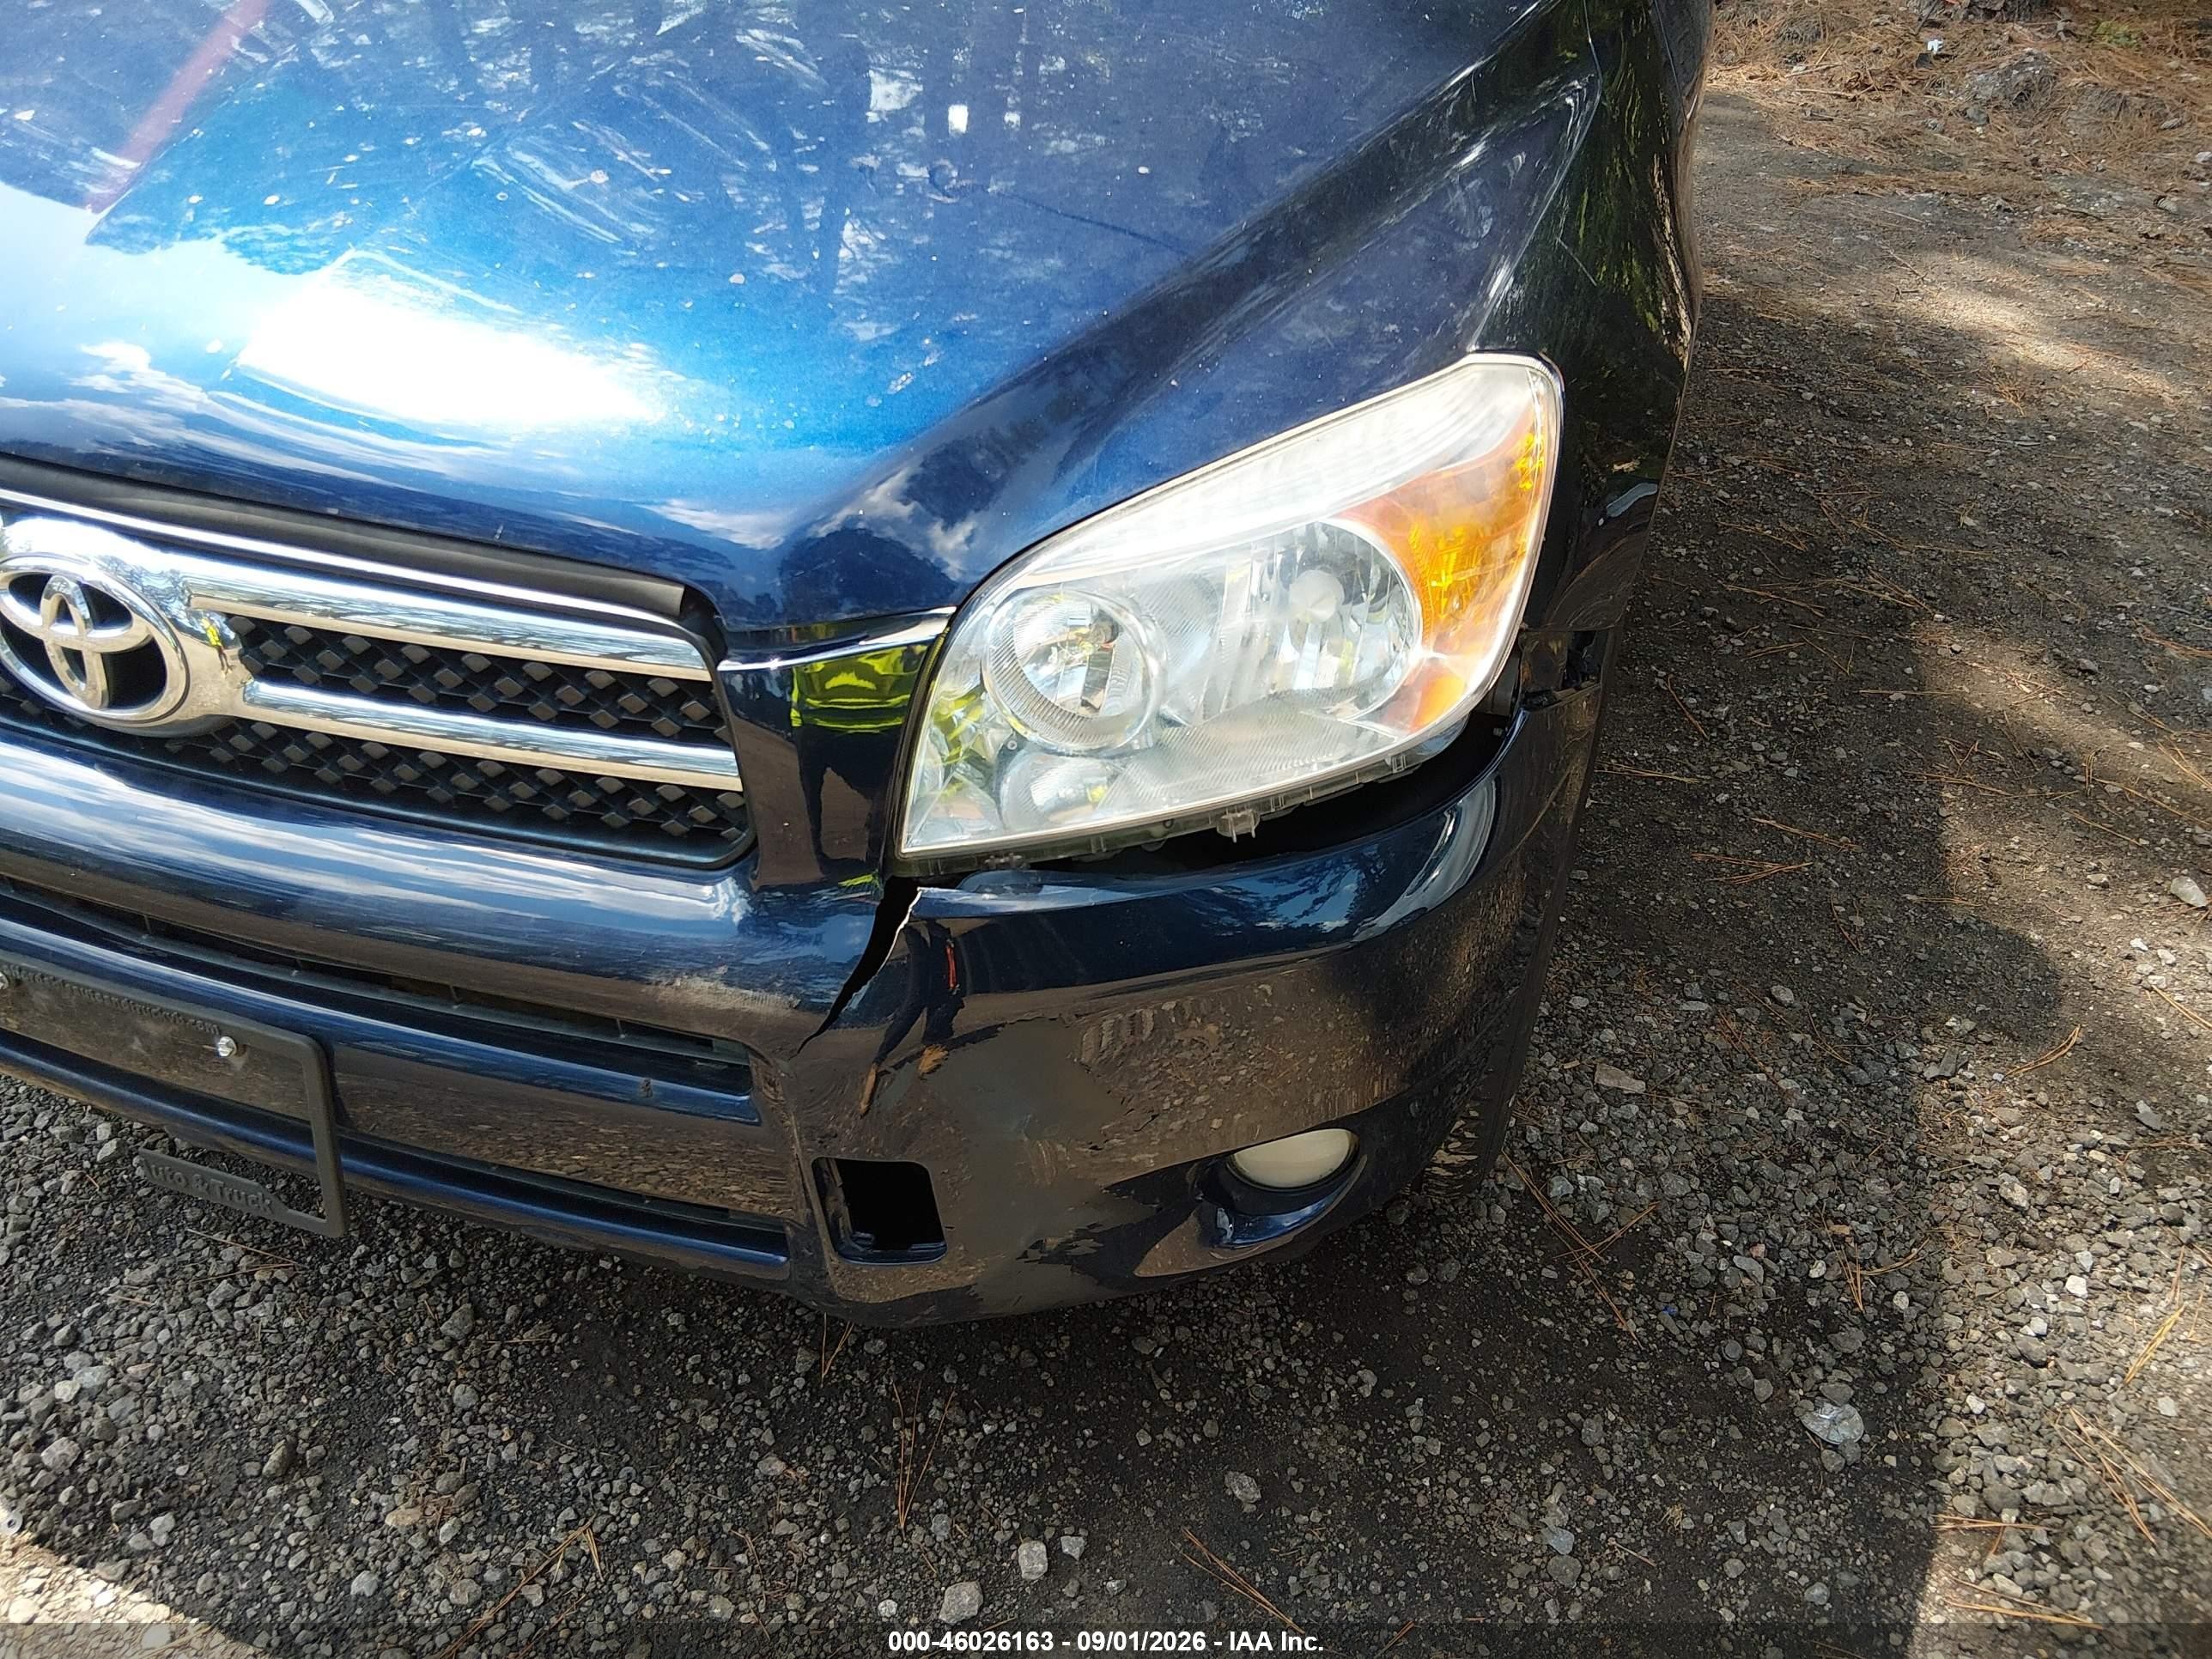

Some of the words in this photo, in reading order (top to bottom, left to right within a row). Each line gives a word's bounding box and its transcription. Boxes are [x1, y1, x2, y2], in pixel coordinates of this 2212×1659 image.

[145, 1164, 187, 1187] uto
[192, 1173, 209, 1193] &
[210, 1177, 275, 1214] Truck
